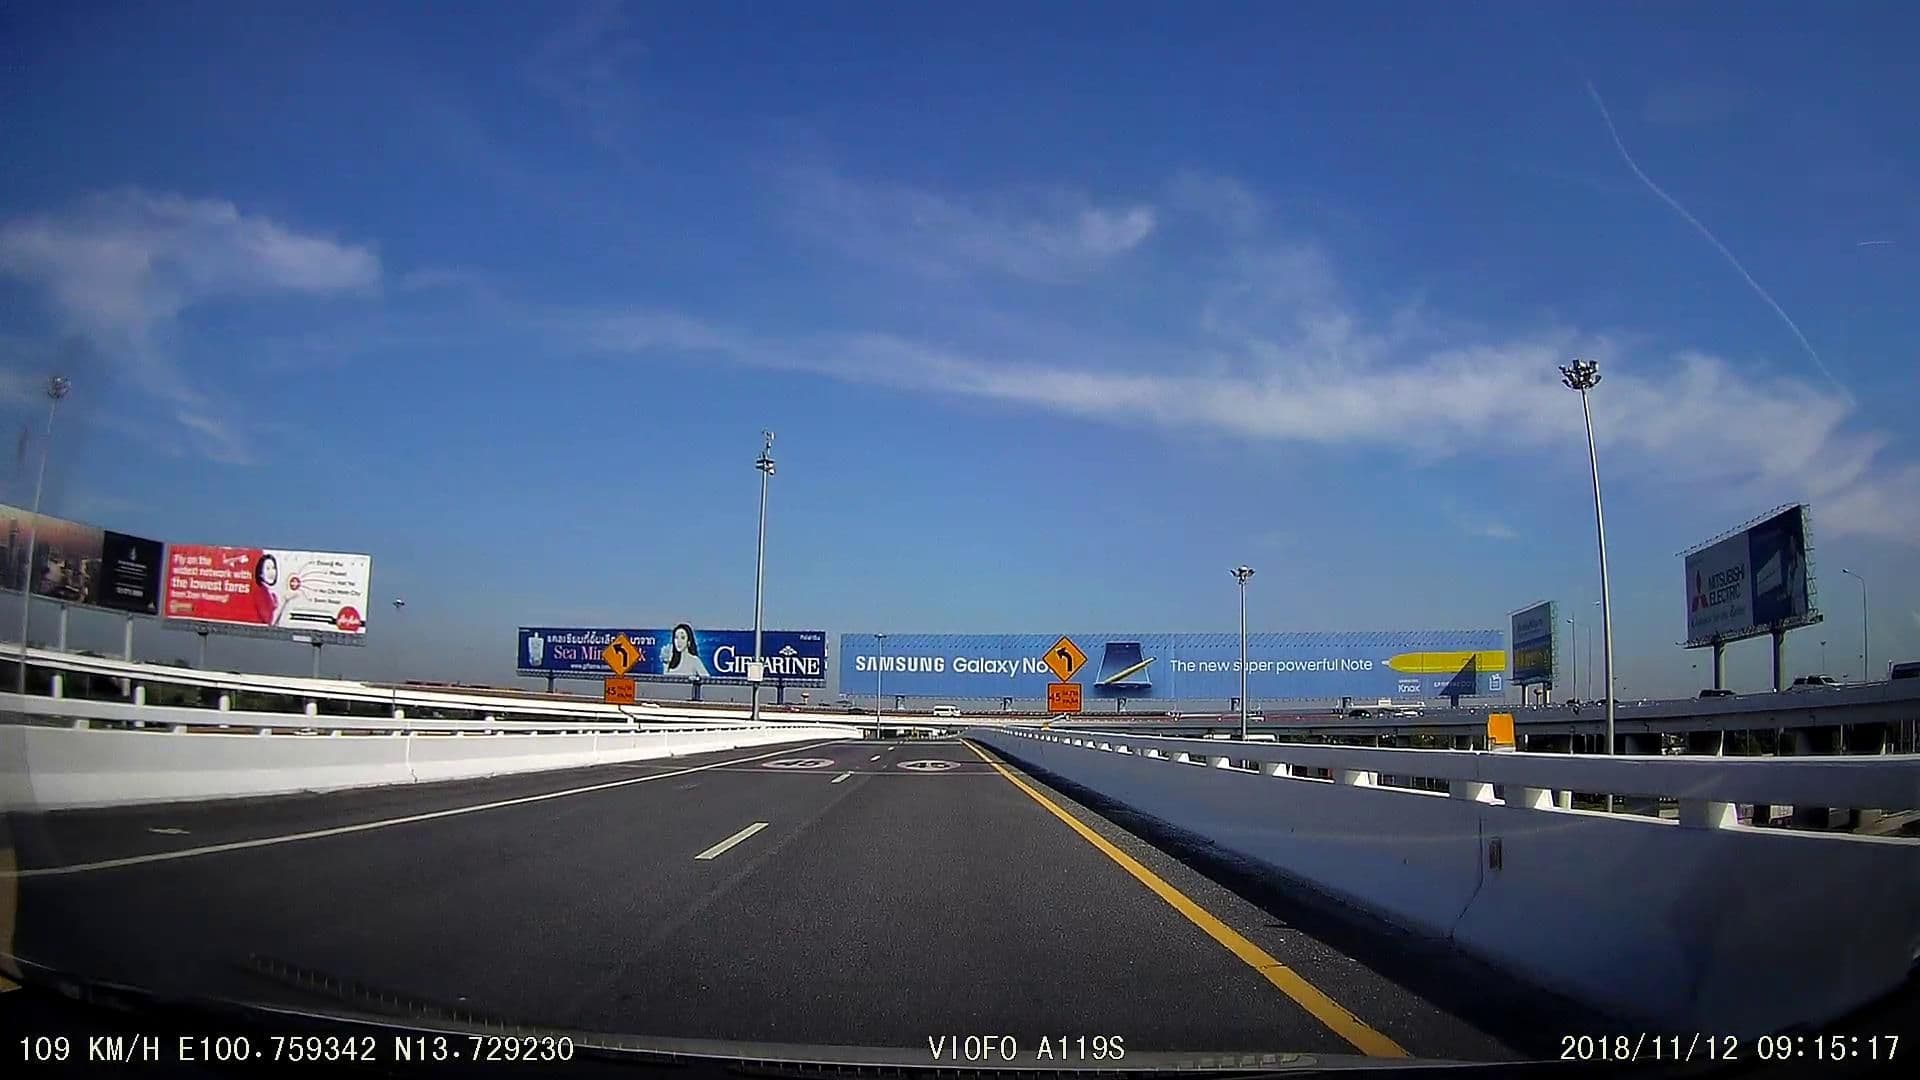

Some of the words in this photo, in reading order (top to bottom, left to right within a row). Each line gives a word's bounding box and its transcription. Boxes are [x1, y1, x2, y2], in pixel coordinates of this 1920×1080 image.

[199, 568, 232, 578] network
[233, 570, 252, 579] with
[172, 577, 188, 588] the
[190, 577, 222, 591] lowest
[224, 580, 250, 593] fares
[1709, 583, 1742, 607] ELECTRIC
[553, 645, 577, 660] Sea
[713, 645, 820, 675] GIFARINE
[855, 655, 945, 672] SAMSUNG
[952, 656, 1020, 678] Galaxy
[1170, 659, 1196, 672] The
[1199, 661, 1230, 672] new
[1276, 658, 1338, 675] powerful
[1341, 658, 1373, 671] Note
[1398, 683, 1421, 693] Knox
